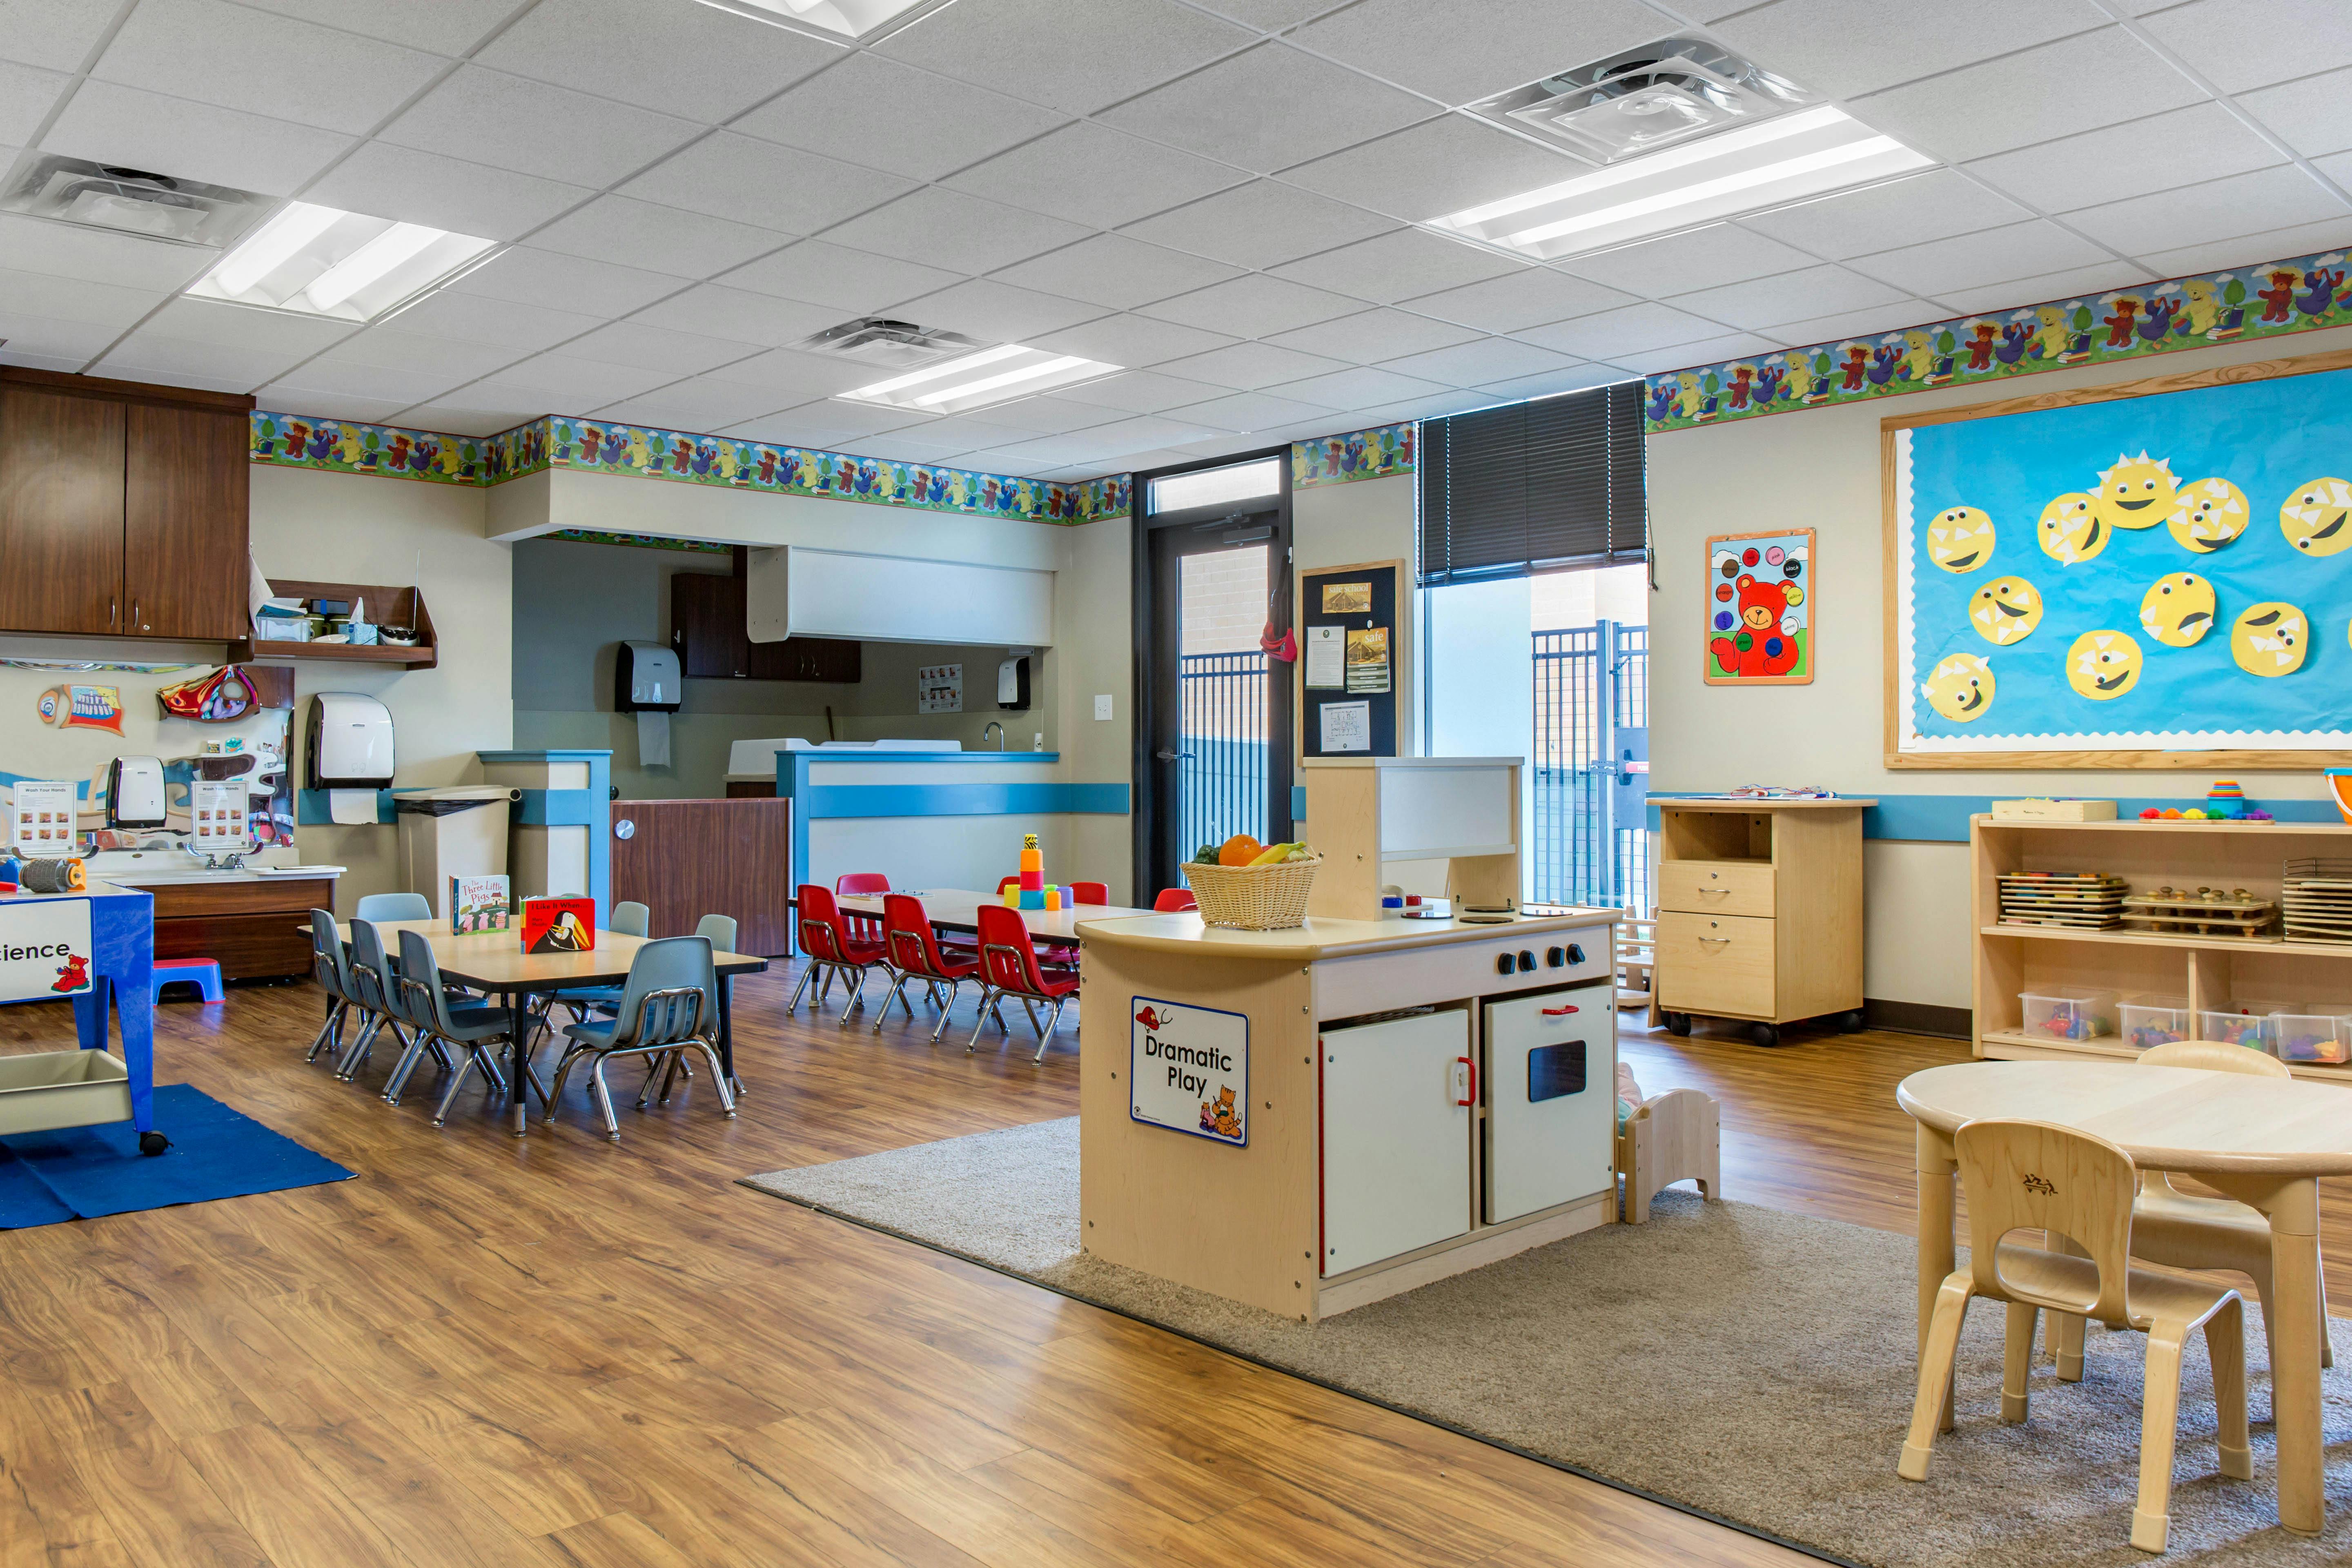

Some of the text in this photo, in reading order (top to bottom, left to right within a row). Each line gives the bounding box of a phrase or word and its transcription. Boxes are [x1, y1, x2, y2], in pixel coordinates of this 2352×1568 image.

[1344, 583, 1369, 592] school
[1365, 630, 1383, 644] safe
[462, 880, 502, 896] Three Little
[471, 893, 490, 904] Pigs
[0, 944, 70, 961] ience
[1145, 1035, 1232, 1072] Dramatic
[1168, 1066, 1207, 1098] Play
